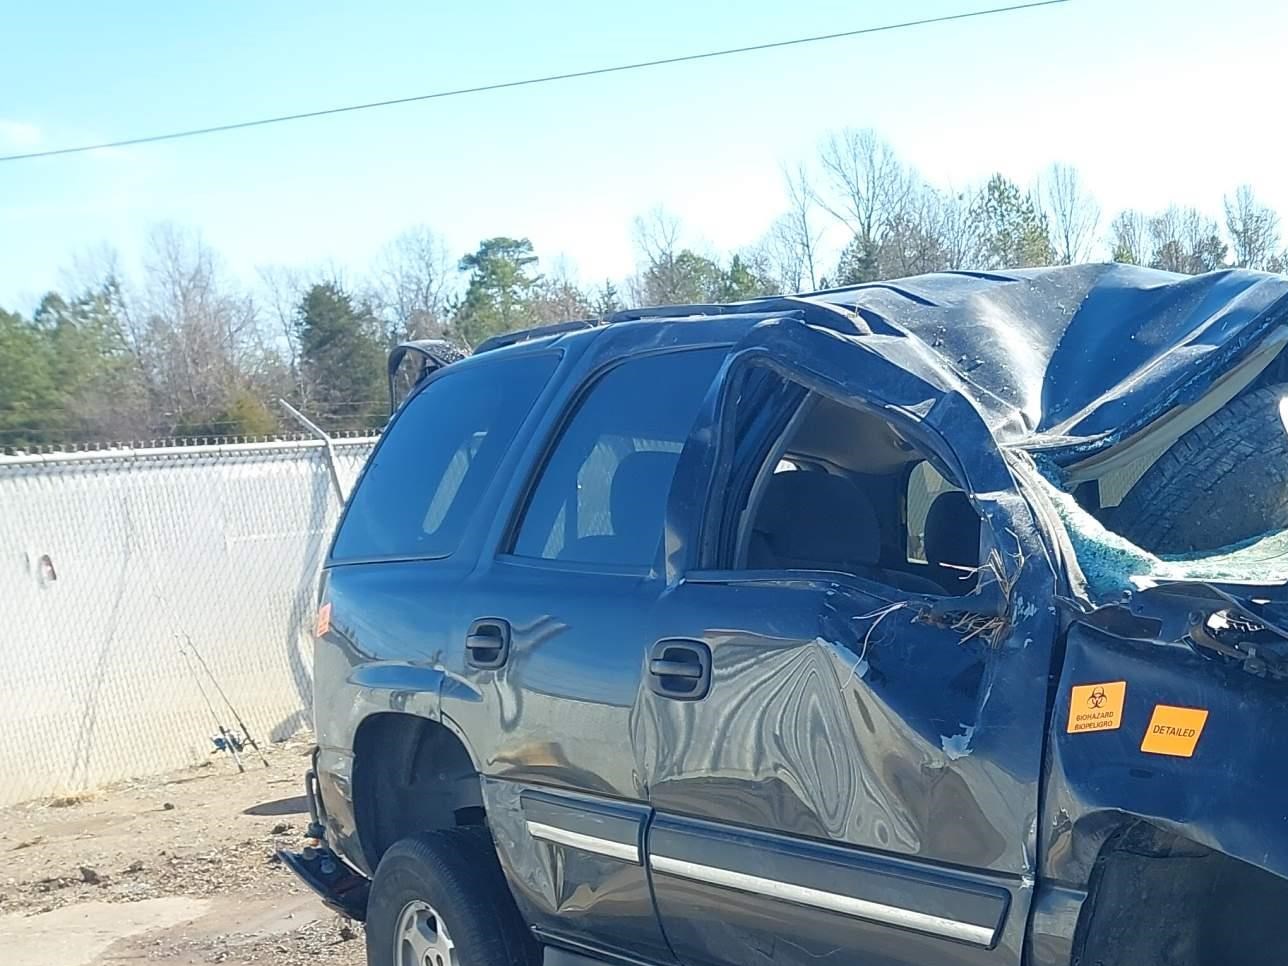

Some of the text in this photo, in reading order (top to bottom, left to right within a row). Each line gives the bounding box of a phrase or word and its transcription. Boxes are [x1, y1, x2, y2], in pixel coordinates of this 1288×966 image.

[1076, 711, 1114, 722] BIOHAZARD
[1074, 720, 1113, 731] BIOPELIGRO
[1152, 724, 1196, 738] DETAILED
